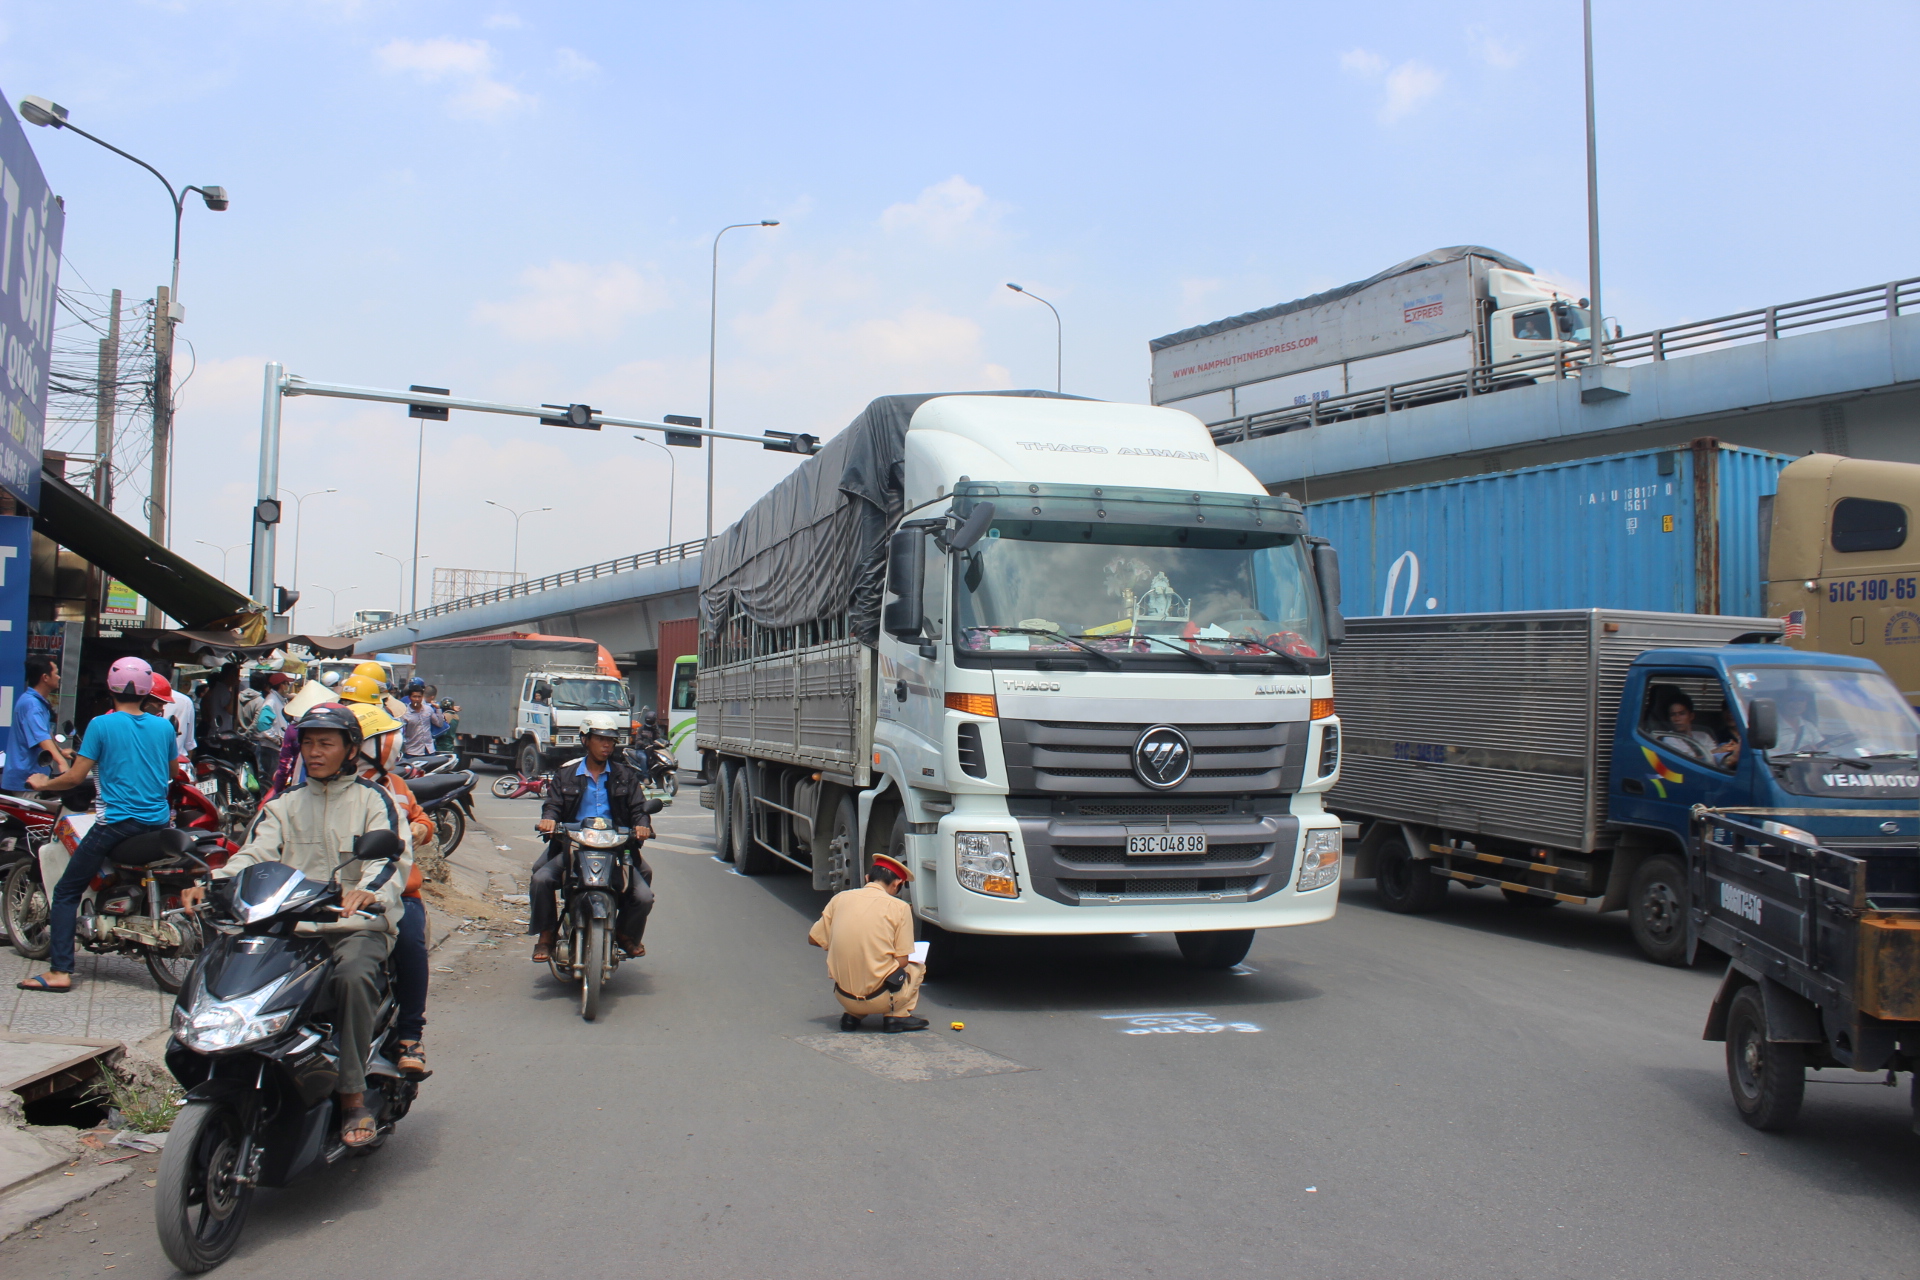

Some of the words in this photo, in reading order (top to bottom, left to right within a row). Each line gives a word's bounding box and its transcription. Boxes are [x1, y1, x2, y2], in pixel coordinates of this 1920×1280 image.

[1404, 305, 1443, 323] EXPRESS
[1173, 336, 1318, 378] WWW.NAMPHUTHINHEXPRESS.COM
[1016, 441, 1108, 454] THACO
[1118, 447, 1209, 461] AUMAN
[1003, 679, 1060, 691] THACO
[1254, 684, 1306, 695] AUMAN
[1130, 835, 1204, 853] 63C-048.98
